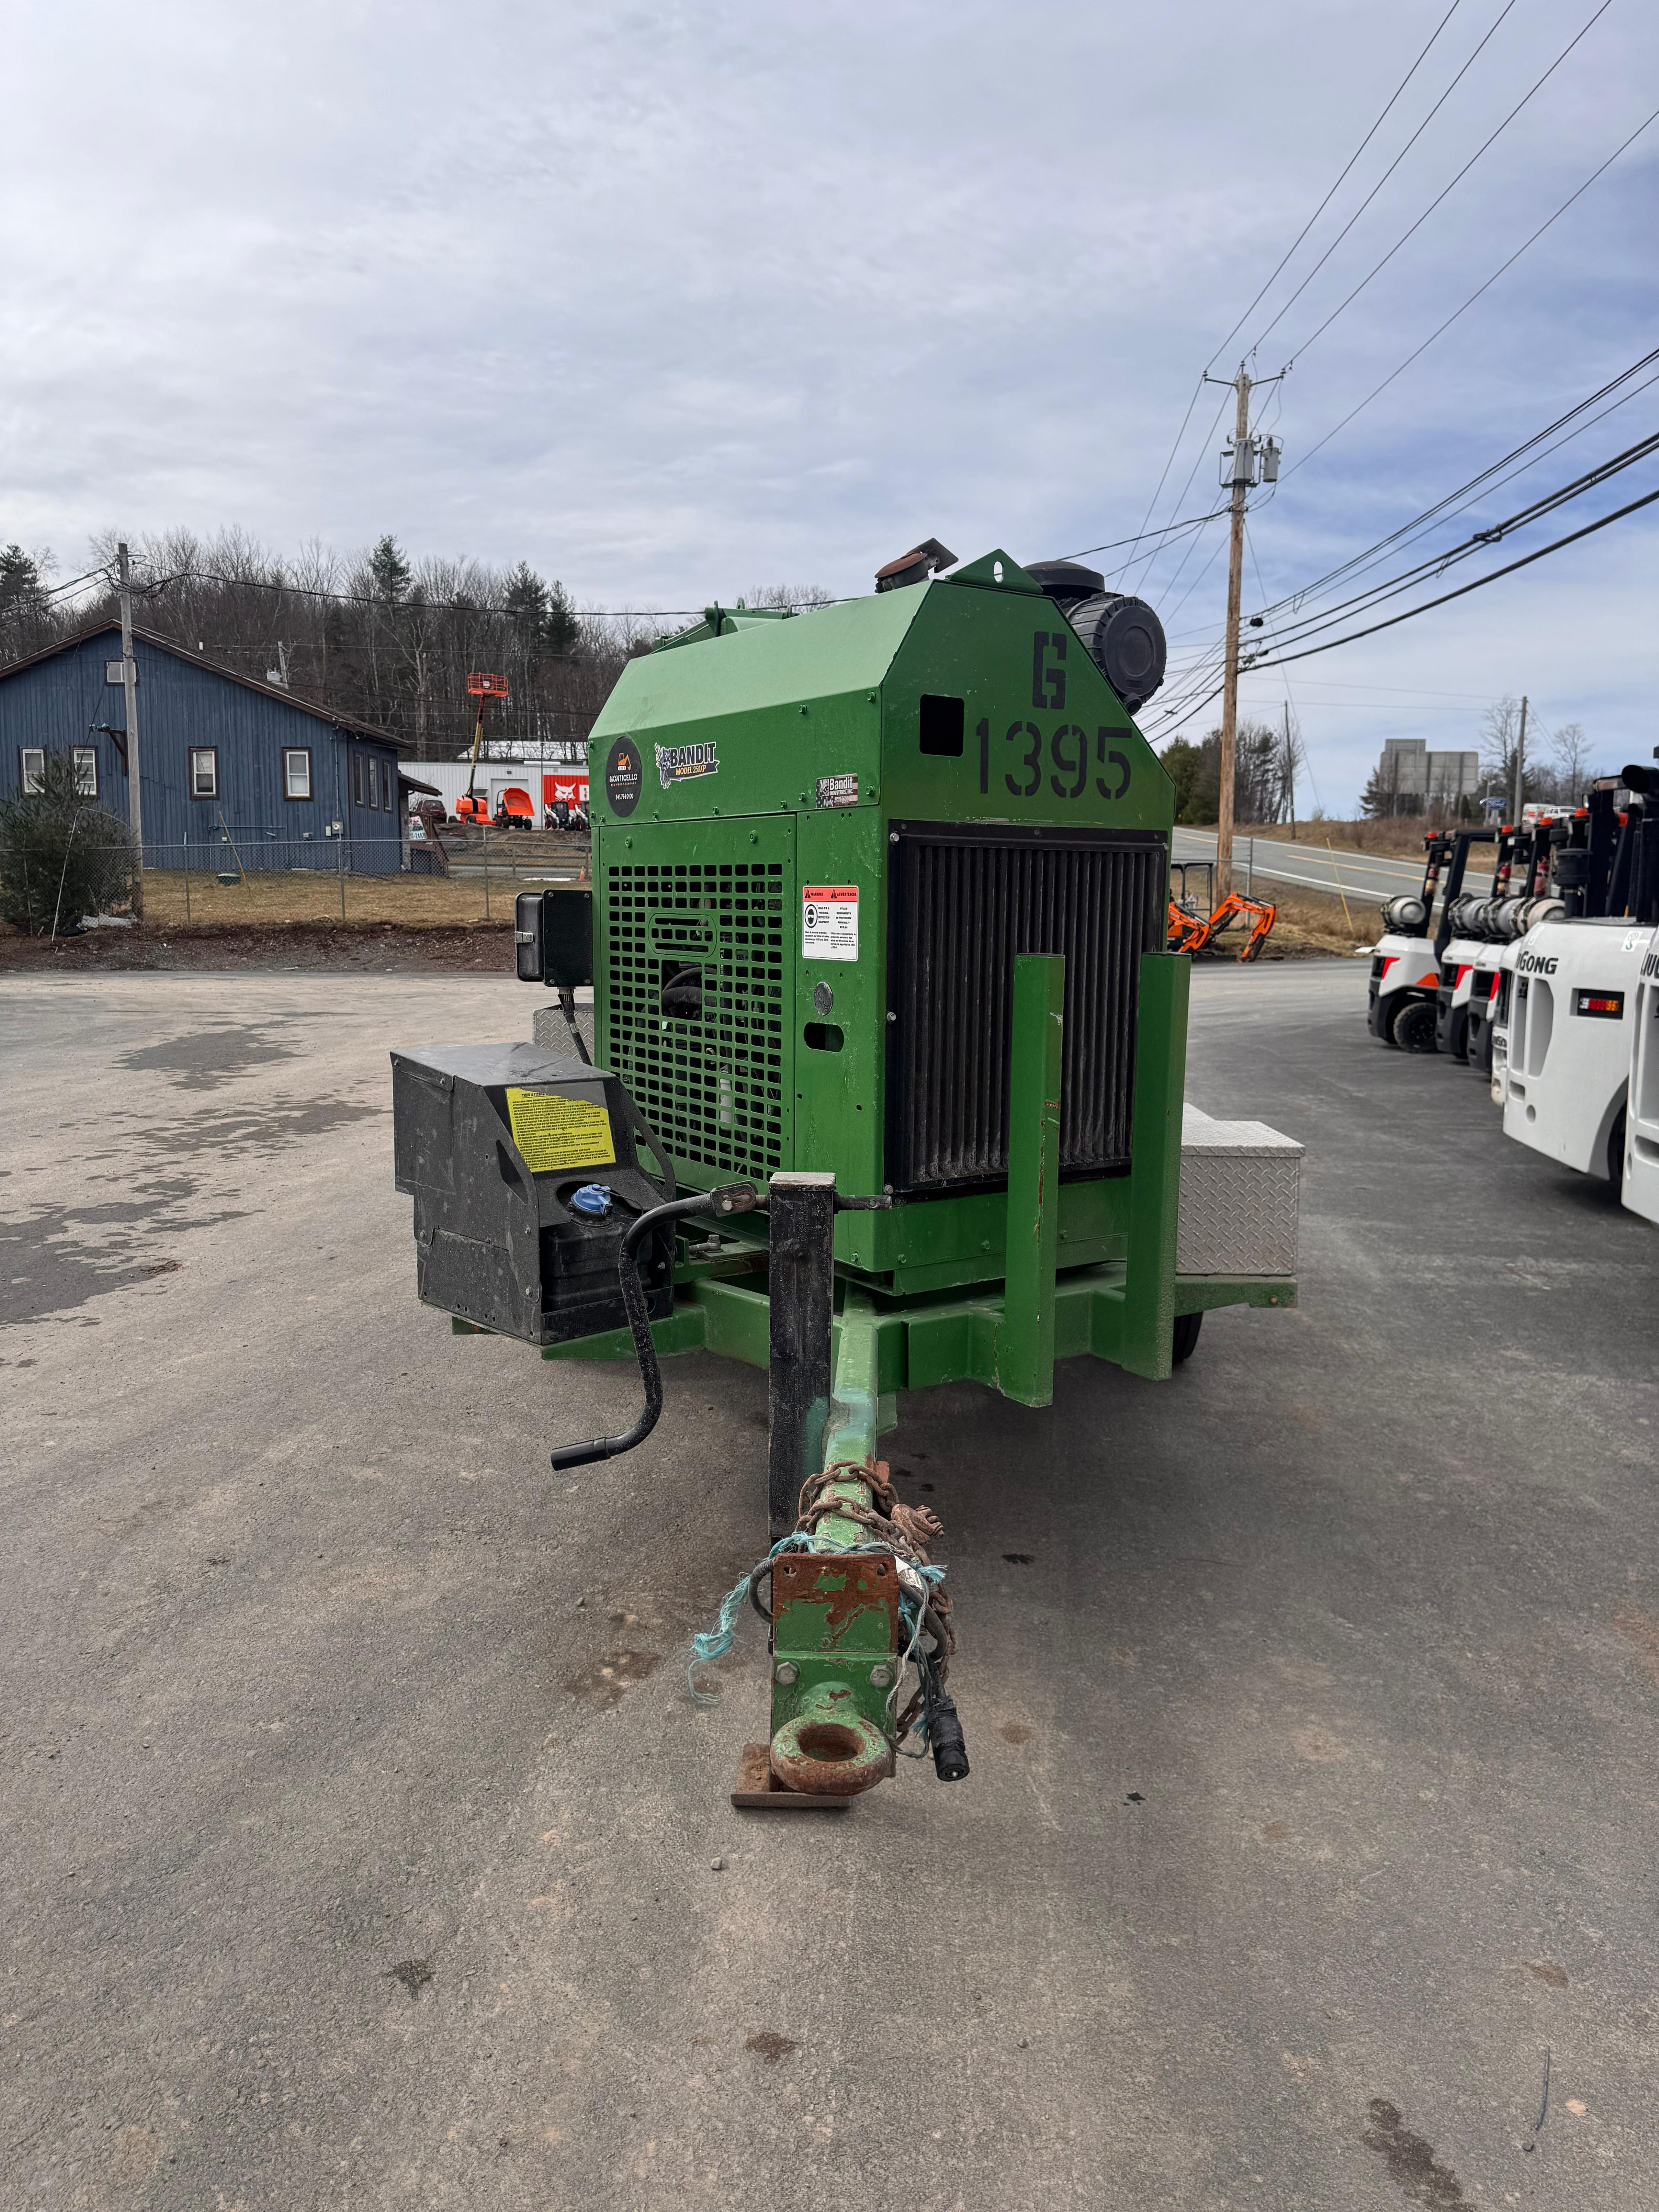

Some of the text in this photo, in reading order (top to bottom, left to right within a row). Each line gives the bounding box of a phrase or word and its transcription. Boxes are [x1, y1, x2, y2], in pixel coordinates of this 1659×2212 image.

[1032, 631, 1067, 710] G
[671, 743, 715, 767] BANDIT
[976, 718, 1132, 800] 1395
[609, 773, 638, 782] MONTICELLO
[830, 776, 853, 790] Bandit
